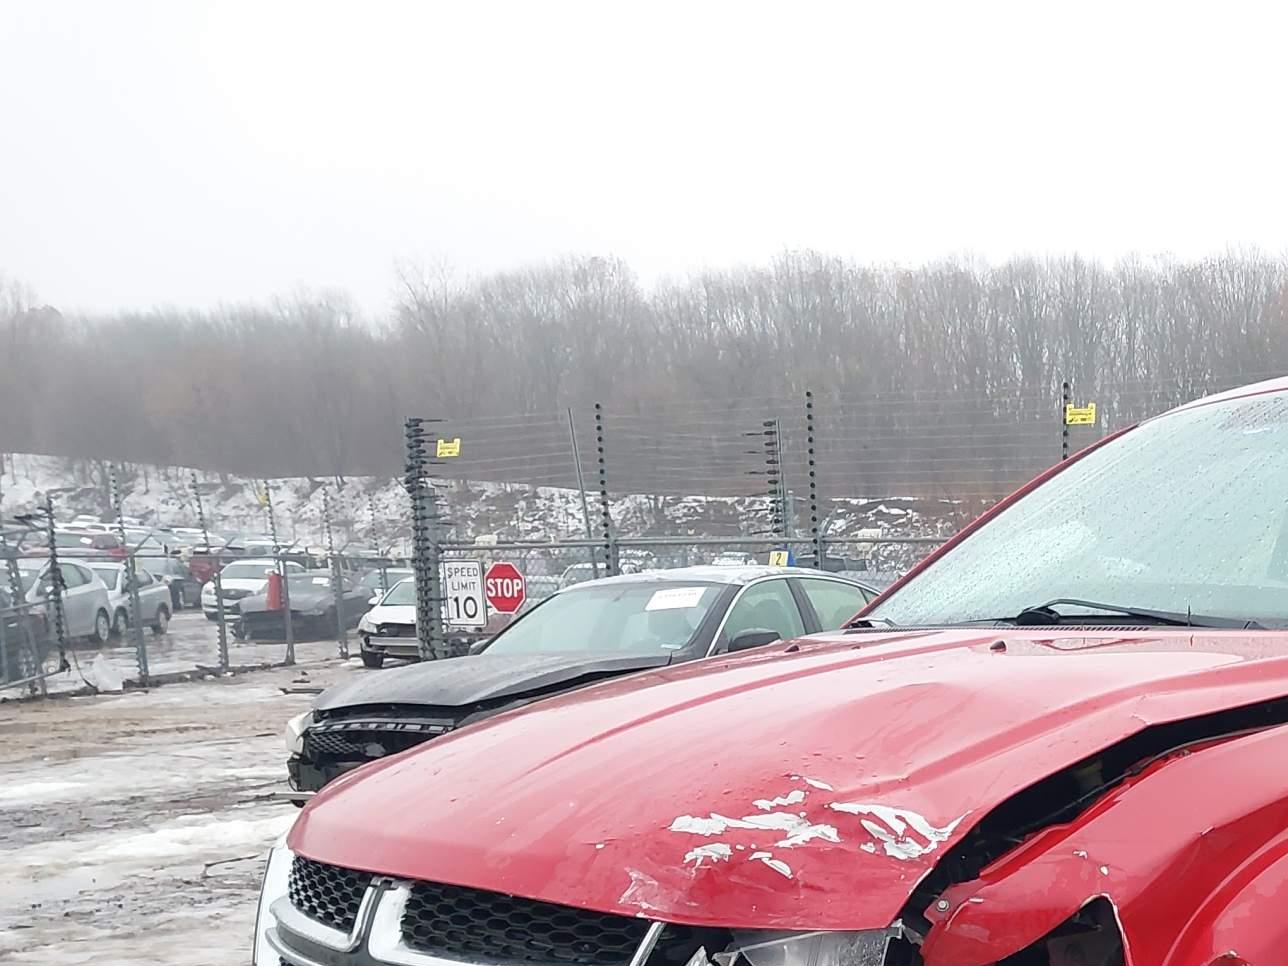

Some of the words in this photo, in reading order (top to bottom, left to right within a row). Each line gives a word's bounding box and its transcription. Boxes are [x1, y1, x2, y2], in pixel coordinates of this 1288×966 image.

[447, 567, 479, 578] SPEED
[451, 581, 477, 591] LIMIT
[487, 578, 522, 598] STOP
[453, 596, 478, 619] 10
